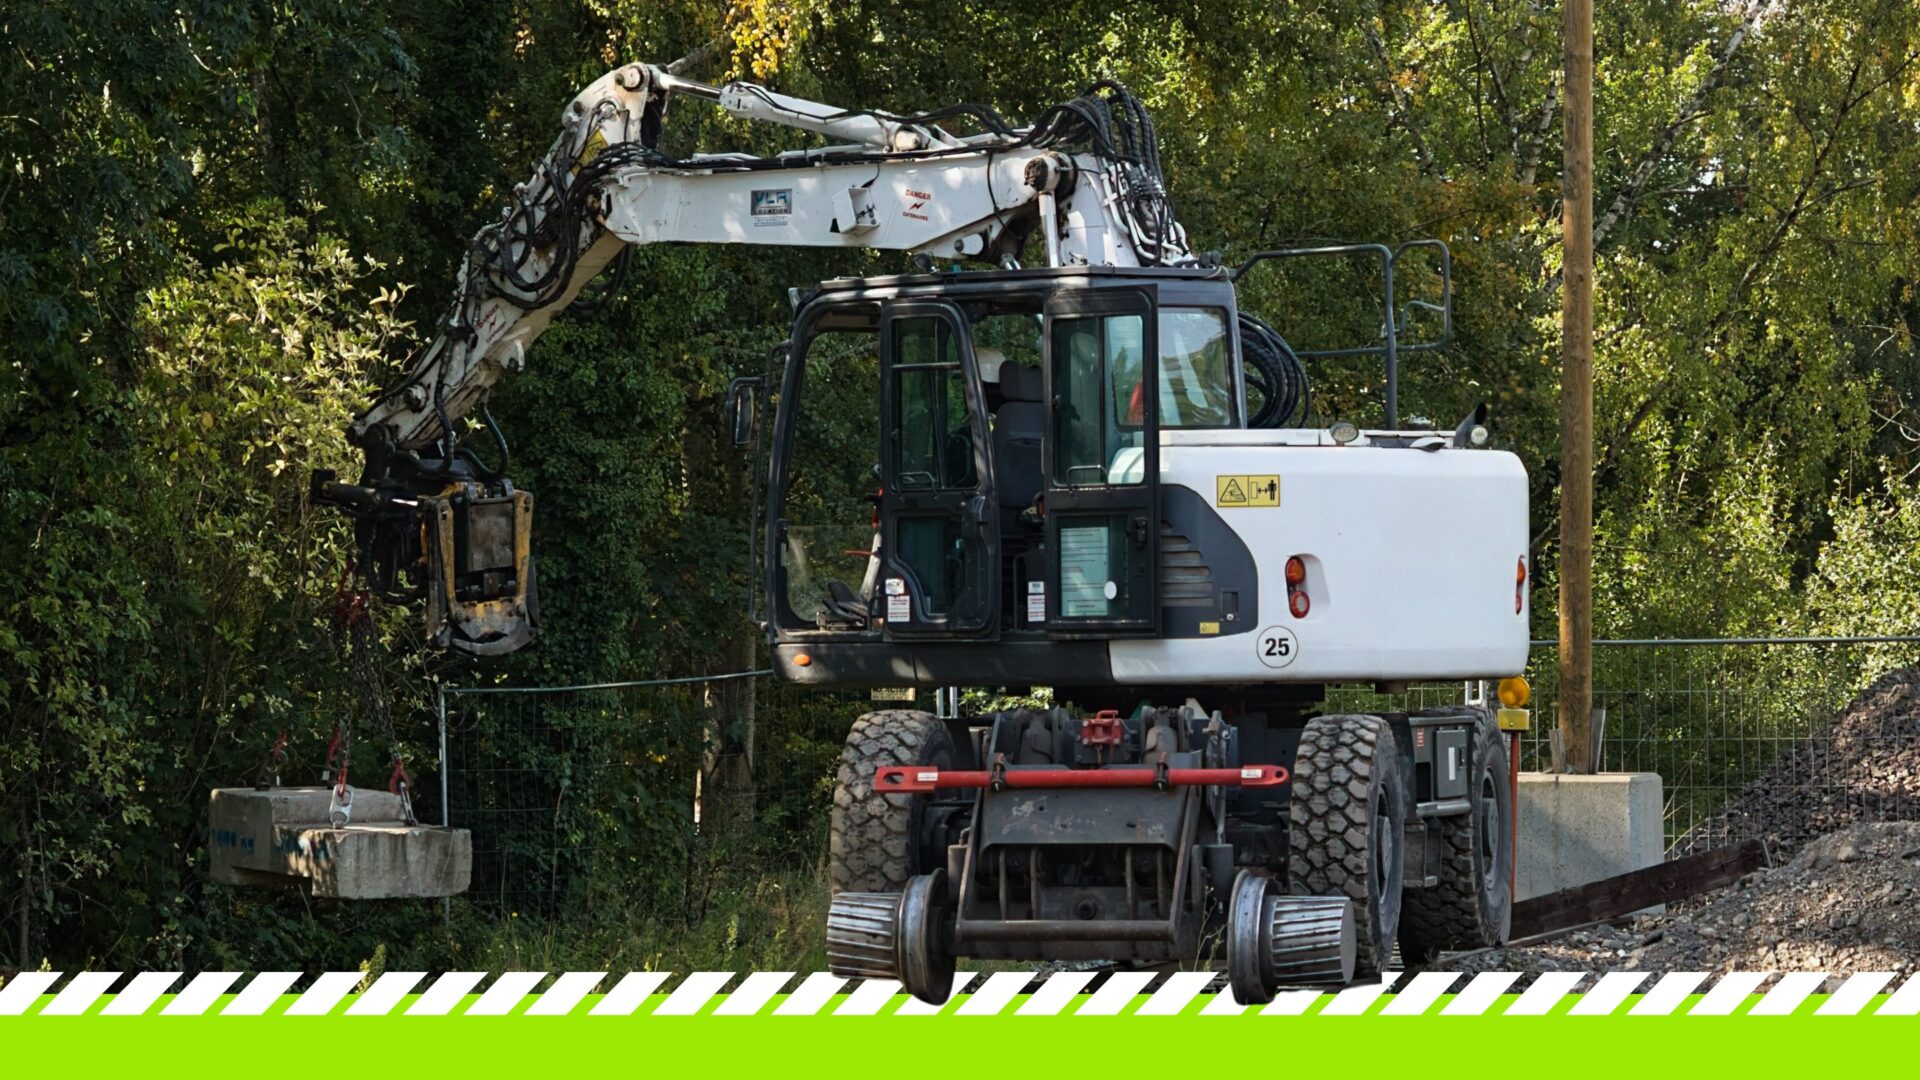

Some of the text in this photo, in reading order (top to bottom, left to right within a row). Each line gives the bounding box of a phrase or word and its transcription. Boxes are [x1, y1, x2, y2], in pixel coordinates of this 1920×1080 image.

[905, 189, 931, 201] DANGER
[752, 207, 788, 216] LOCATION
[1265, 637, 1290, 656] 25
